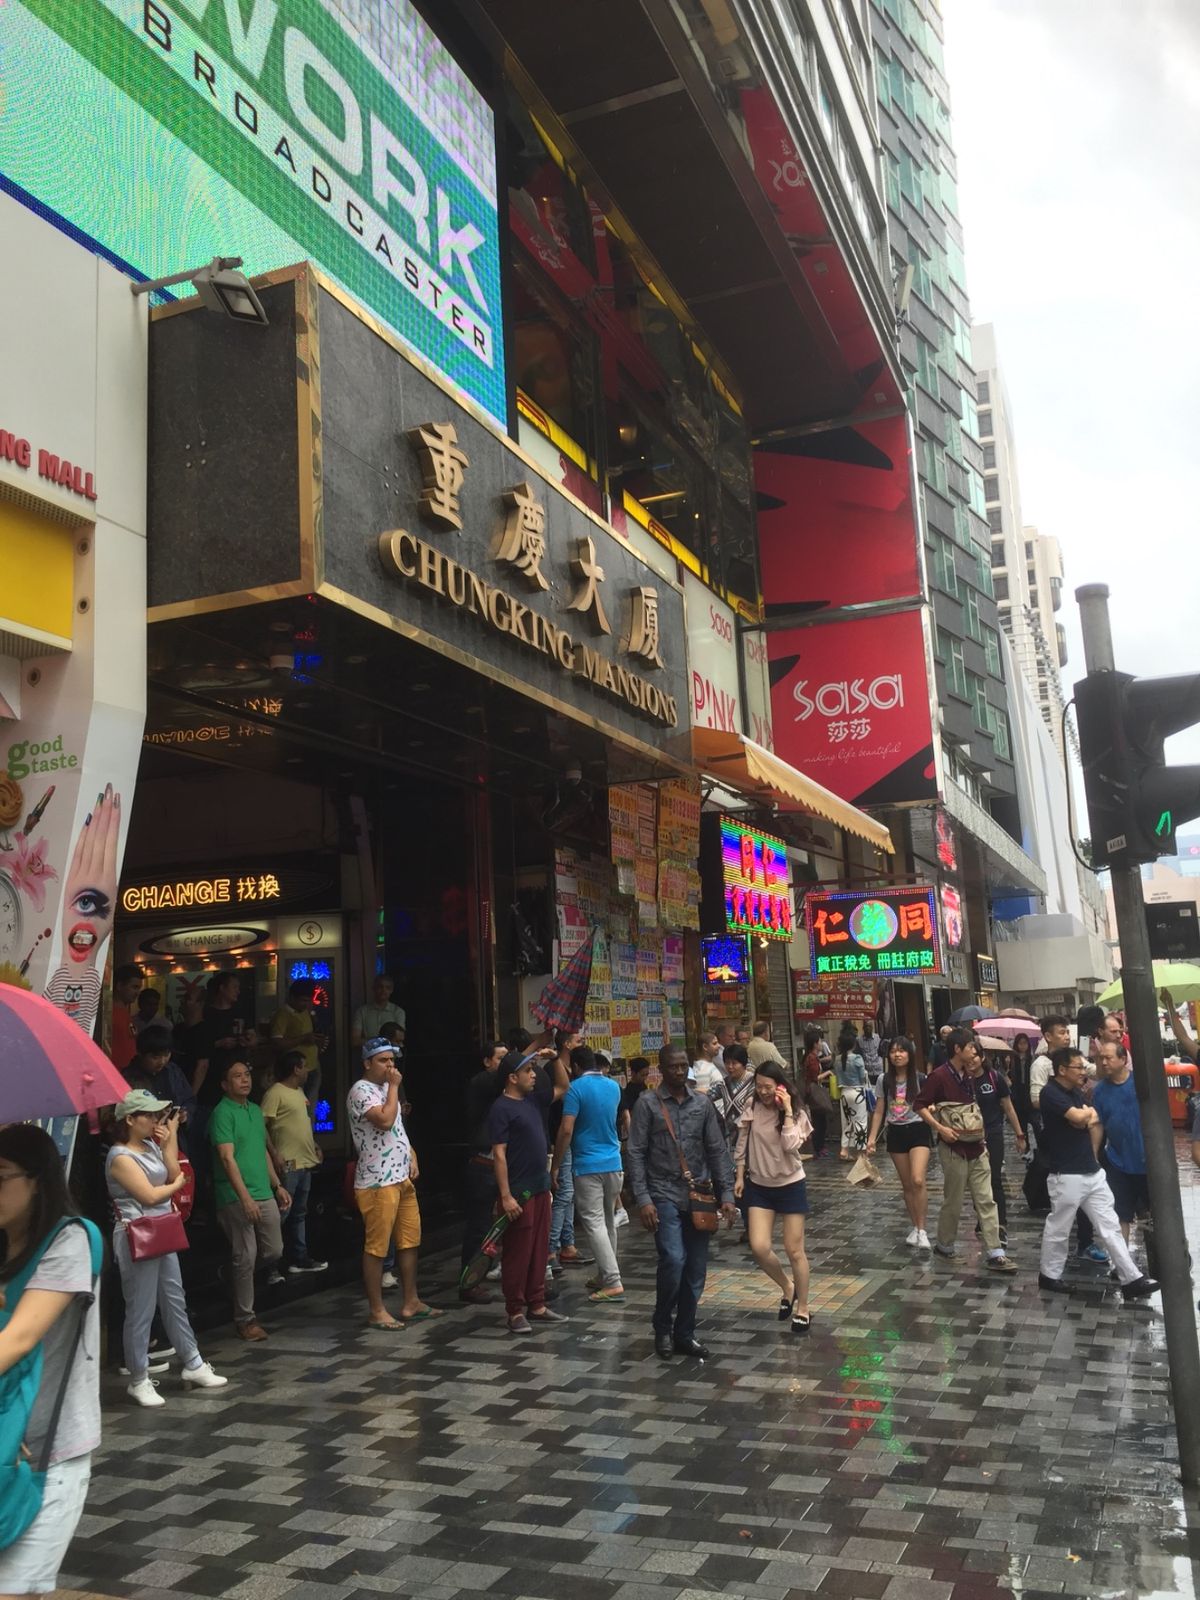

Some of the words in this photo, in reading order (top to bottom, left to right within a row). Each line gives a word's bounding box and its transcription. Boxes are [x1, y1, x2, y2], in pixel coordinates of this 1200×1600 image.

[143, 0, 488, 355] BROADCASTER
[38, 448, 98, 501] MALL
[407, 421, 665, 671] 重慶大廈
[379, 528, 576, 669] CHUNGKING
[572, 642, 678, 728] MANSIONS
[827, 718, 872, 743] 莎莎
[7, 734, 63, 780] good
[31, 753, 78, 773] taste
[123, 878, 230, 912] CHANGE
[236, 873, 281, 902] 找換
[183, 934, 223, 947] CHANGE
